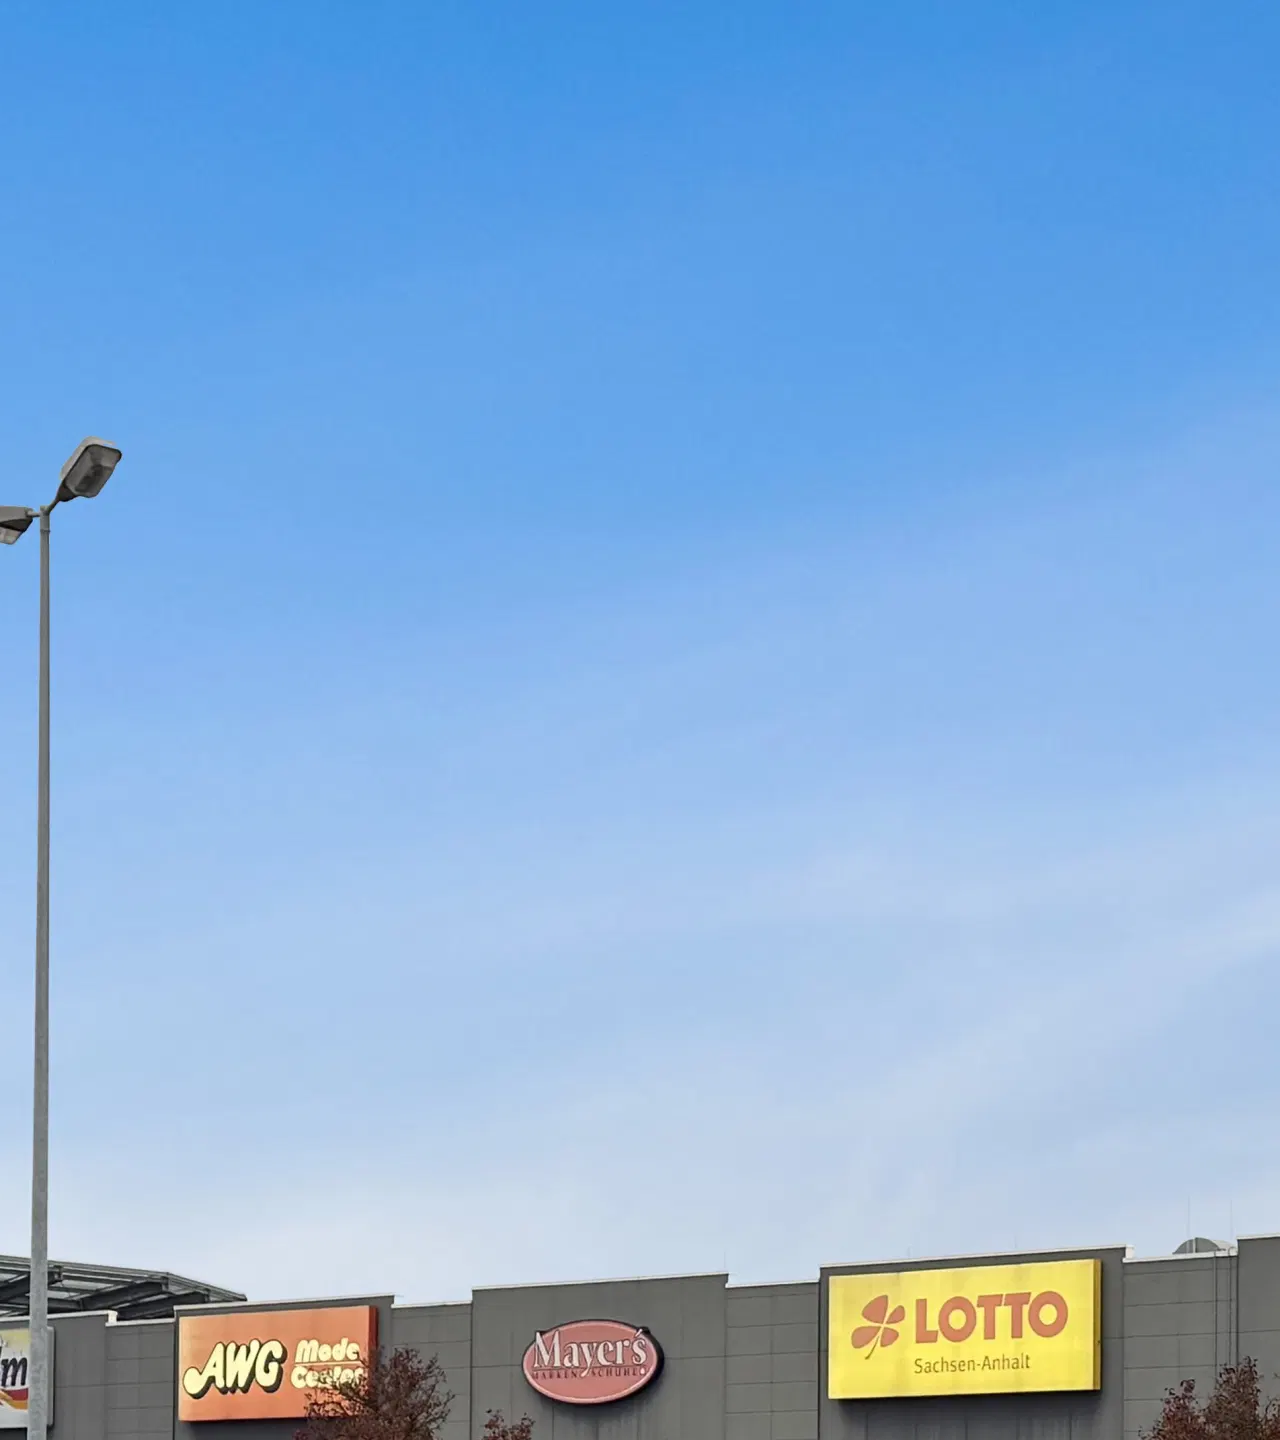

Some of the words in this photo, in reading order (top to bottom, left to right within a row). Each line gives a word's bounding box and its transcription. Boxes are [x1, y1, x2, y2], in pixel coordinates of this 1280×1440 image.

[915, 1291, 1069, 1343] LOTTO
[183, 1338, 288, 1399] AWG
[295, 1337, 361, 1363] Mode
[914, 1353, 1030, 1374] Sachsen-Anhalt
